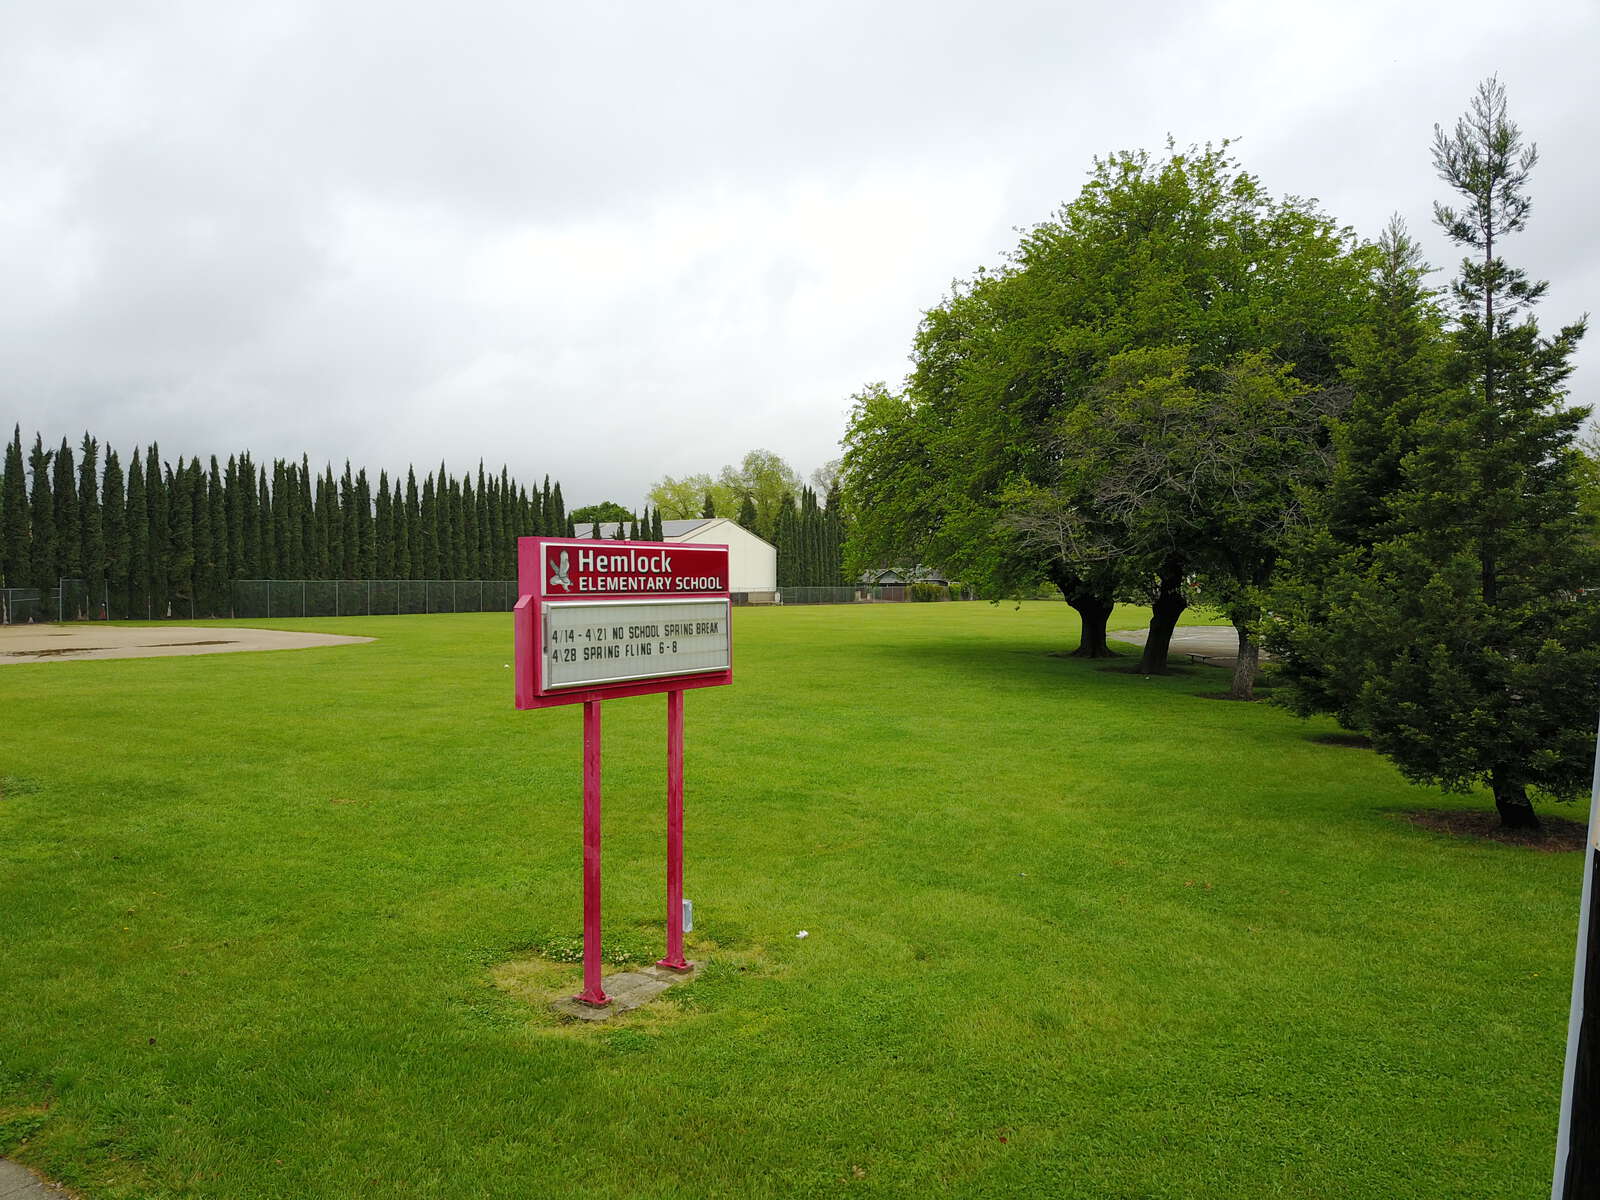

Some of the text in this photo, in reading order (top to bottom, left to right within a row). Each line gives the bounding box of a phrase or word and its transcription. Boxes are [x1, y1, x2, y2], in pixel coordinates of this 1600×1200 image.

[578, 549, 672, 573] Hemlock
[579, 576, 723, 591] ELEMENTARY SCHOOL
[612, 627, 624, 640] NO
[628, 625, 660, 639] SCHOOL
[664, 623, 693, 637] SPRING
[696, 621, 719, 634] BREAK
[583, 645, 619, 660] SPRING
[625, 642, 652, 657] FLING
